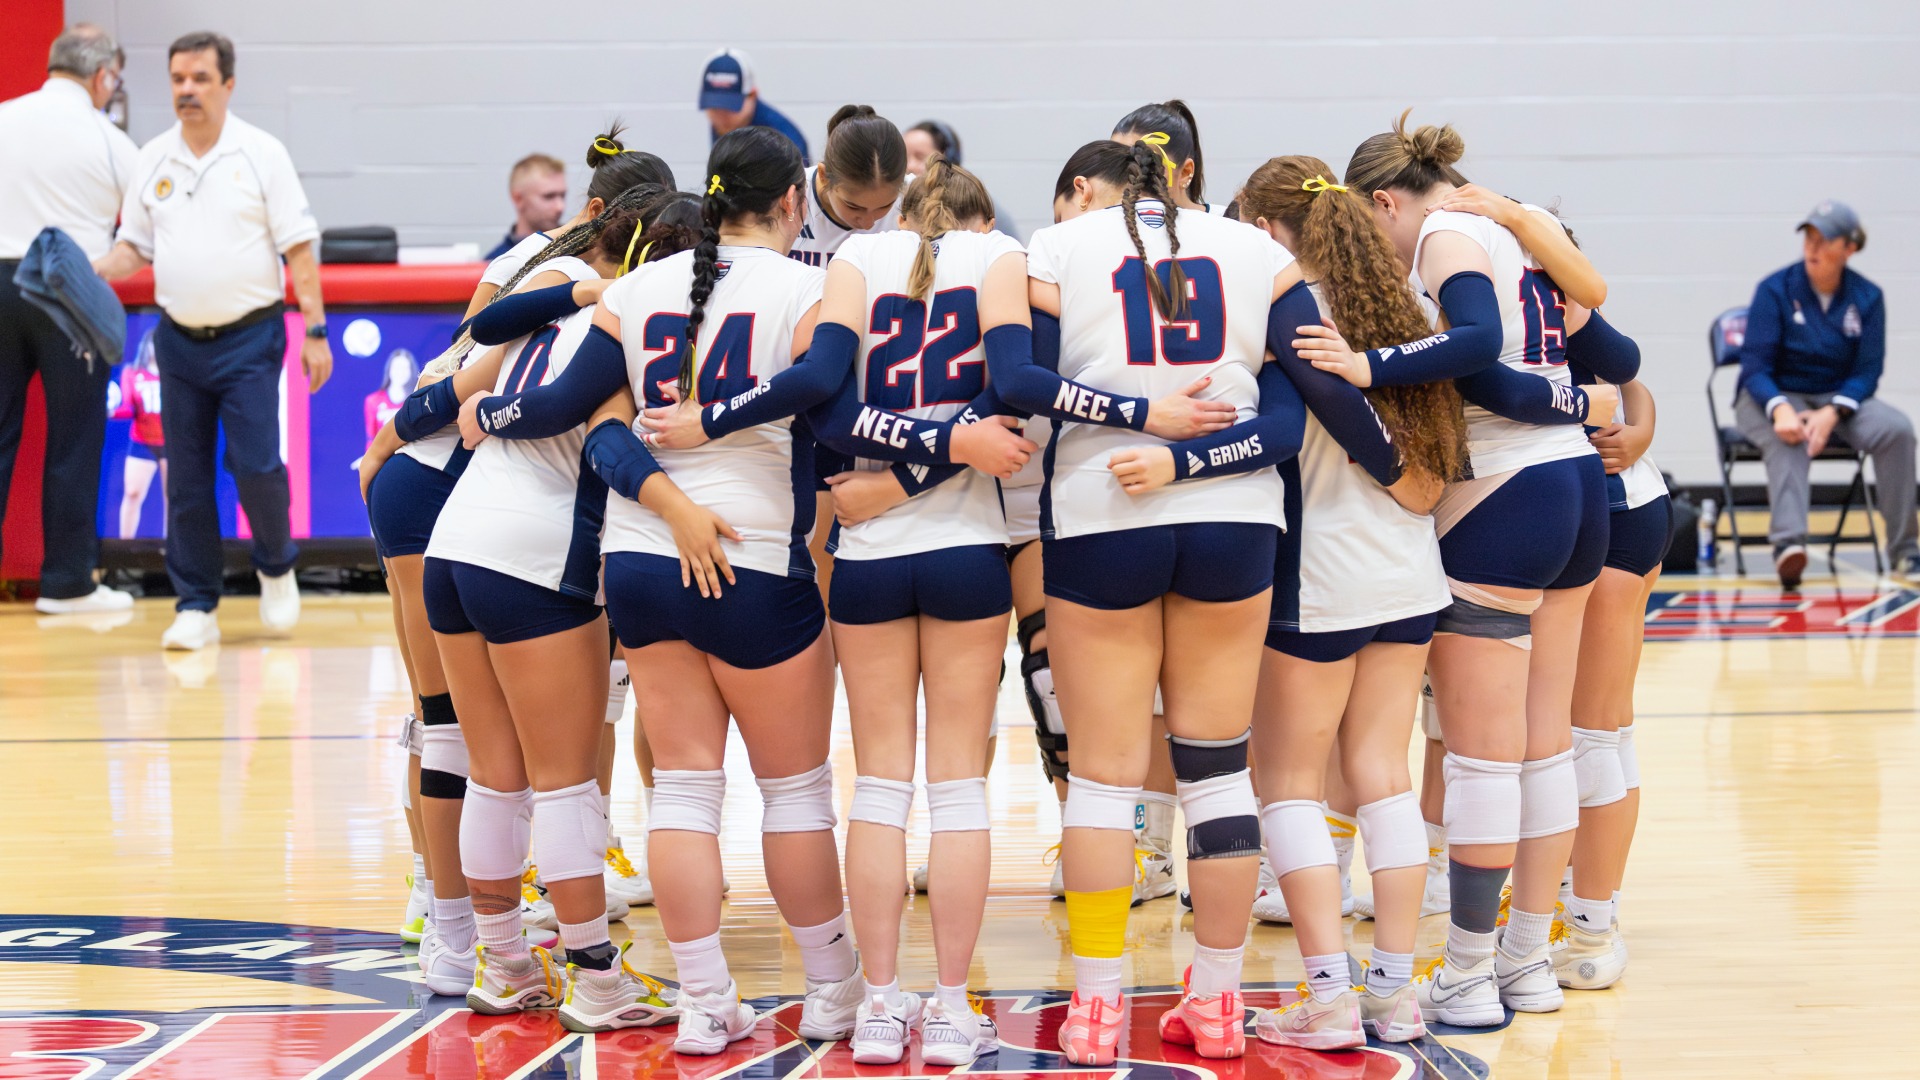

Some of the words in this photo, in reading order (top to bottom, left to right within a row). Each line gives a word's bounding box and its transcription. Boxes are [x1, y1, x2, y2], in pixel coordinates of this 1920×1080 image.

[1111, 255, 1227, 367] 19
[642, 311, 758, 409] 24
[864, 285, 986, 413] 22
[491, 397, 522, 430] GRIMS
[730, 377, 772, 411] GRIMS
[1053, 379, 1112, 422] NEC
[1546, 378, 1575, 415] NEC
[851, 405, 915, 449] NEC
[1207, 433, 1264, 467] GRIMS
